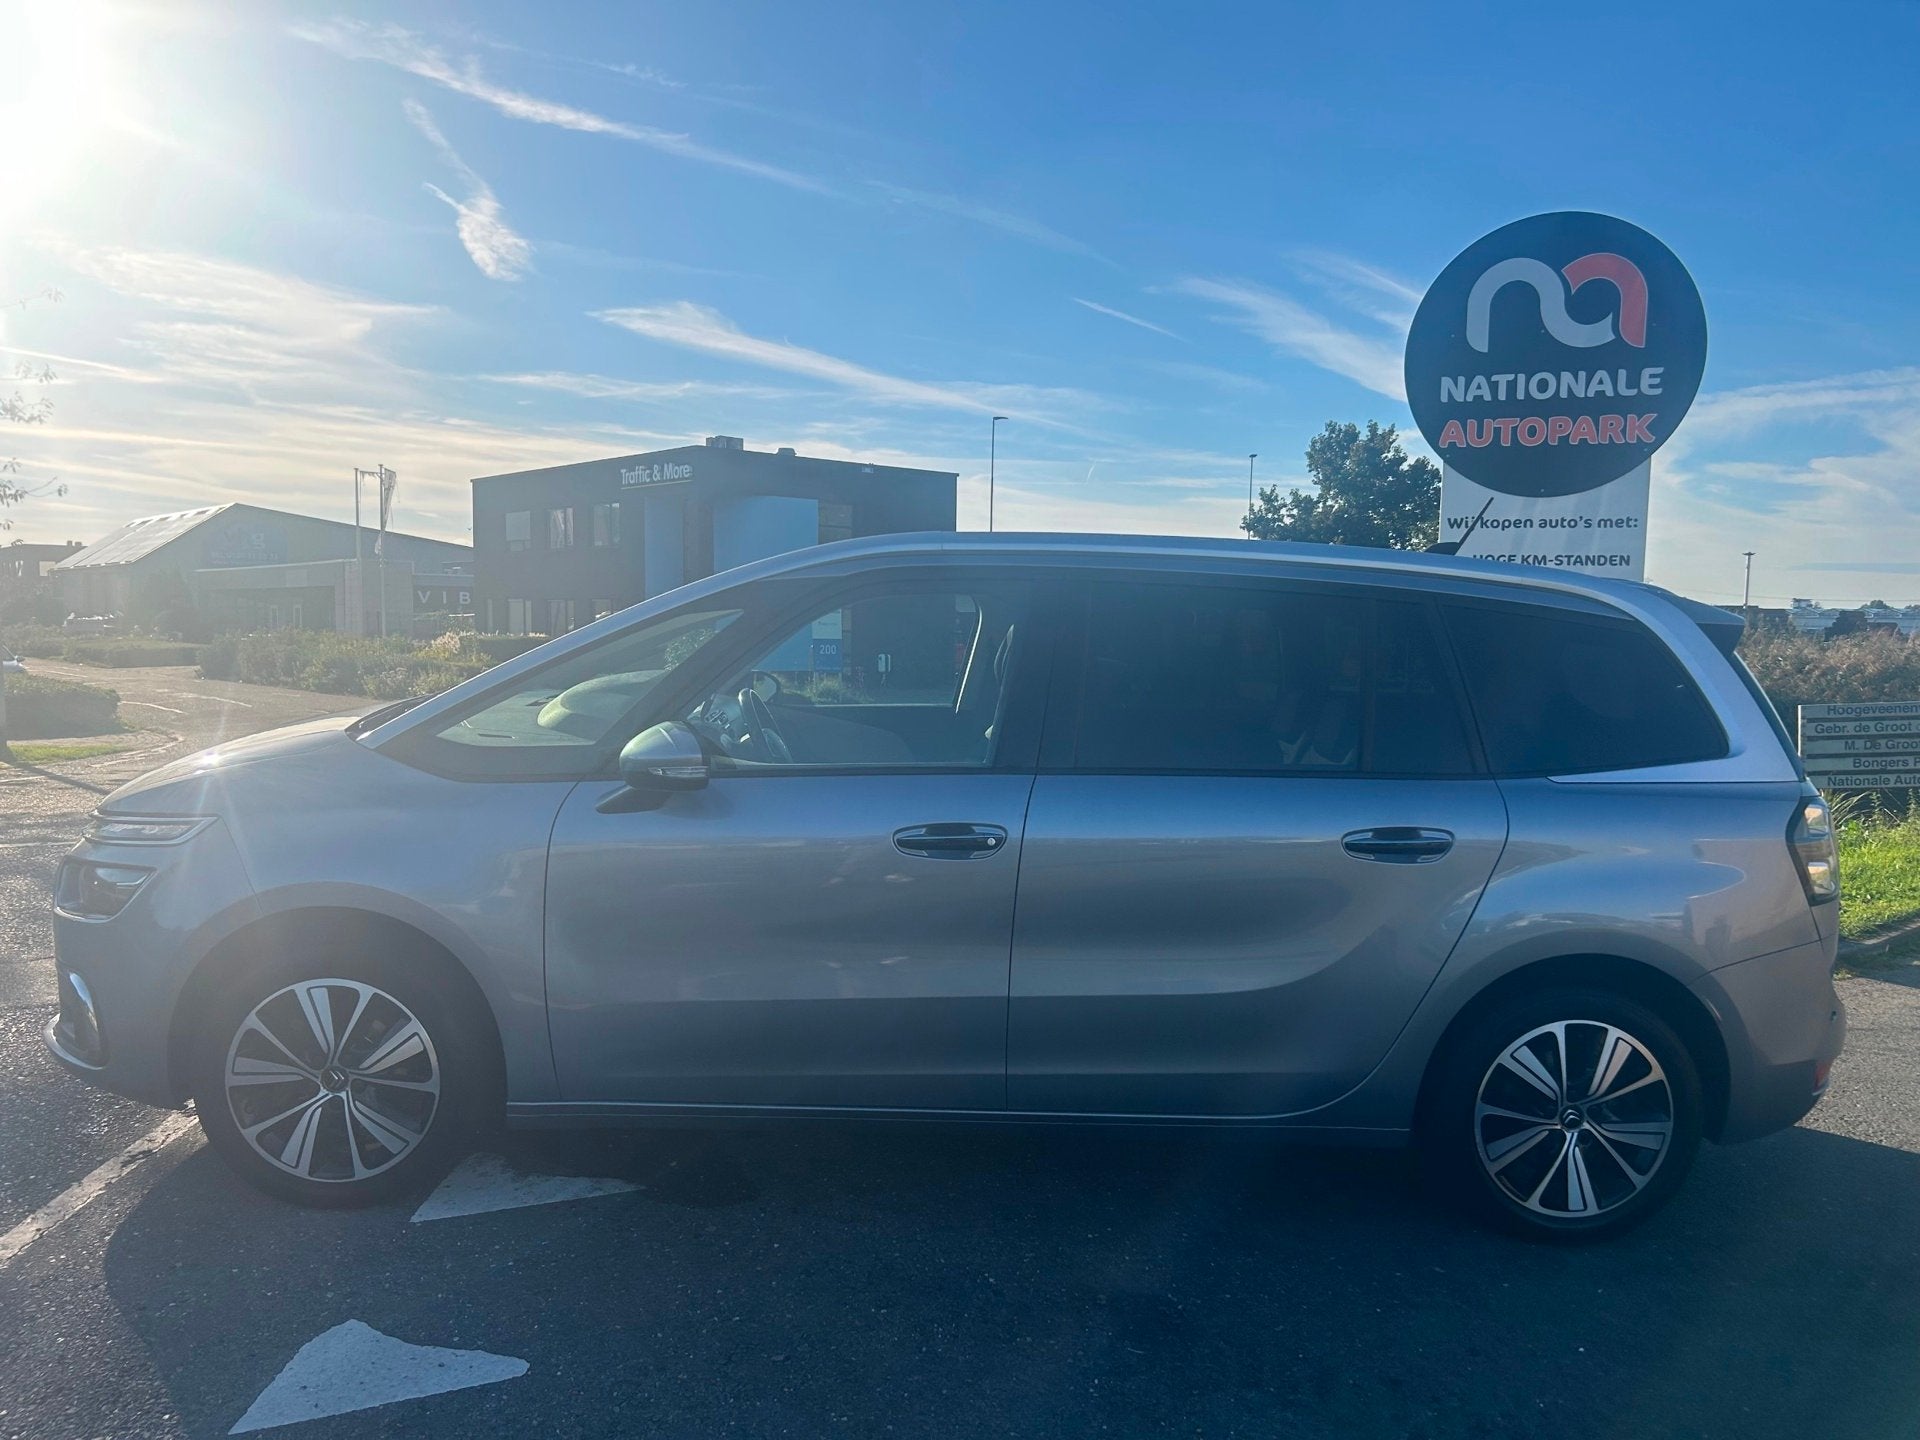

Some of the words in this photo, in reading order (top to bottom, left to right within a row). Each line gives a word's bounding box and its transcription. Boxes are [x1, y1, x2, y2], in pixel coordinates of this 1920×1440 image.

[1440, 366, 1665, 403] NATIONALE
[1438, 413, 1658, 449] AUTOPARK
[620, 465, 651, 485] Traffic
[652, 464, 661, 482] &
[663, 462, 693, 480] More
[1480, 515, 1534, 531] kopen
[1538, 515, 1592, 529] auto's
[1597, 516, 1639, 529] met:
[1520, 554, 1631, 567] KM-STANDEN
[819, 644, 838, 655] 200
[1827, 704, 1920, 717] Hoogeveenen
[1815, 723, 1850, 734] Gebr.
[1854, 722, 1871, 733] de
[1874, 721, 1912, 733] Groot
[1844, 740, 1859, 751] M.
[1863, 740, 1880, 751] De
[1885, 739, 1920, 750] Groo
[1852, 758, 1909, 769] Bongers
[1827, 776, 1890, 787] Nationale
